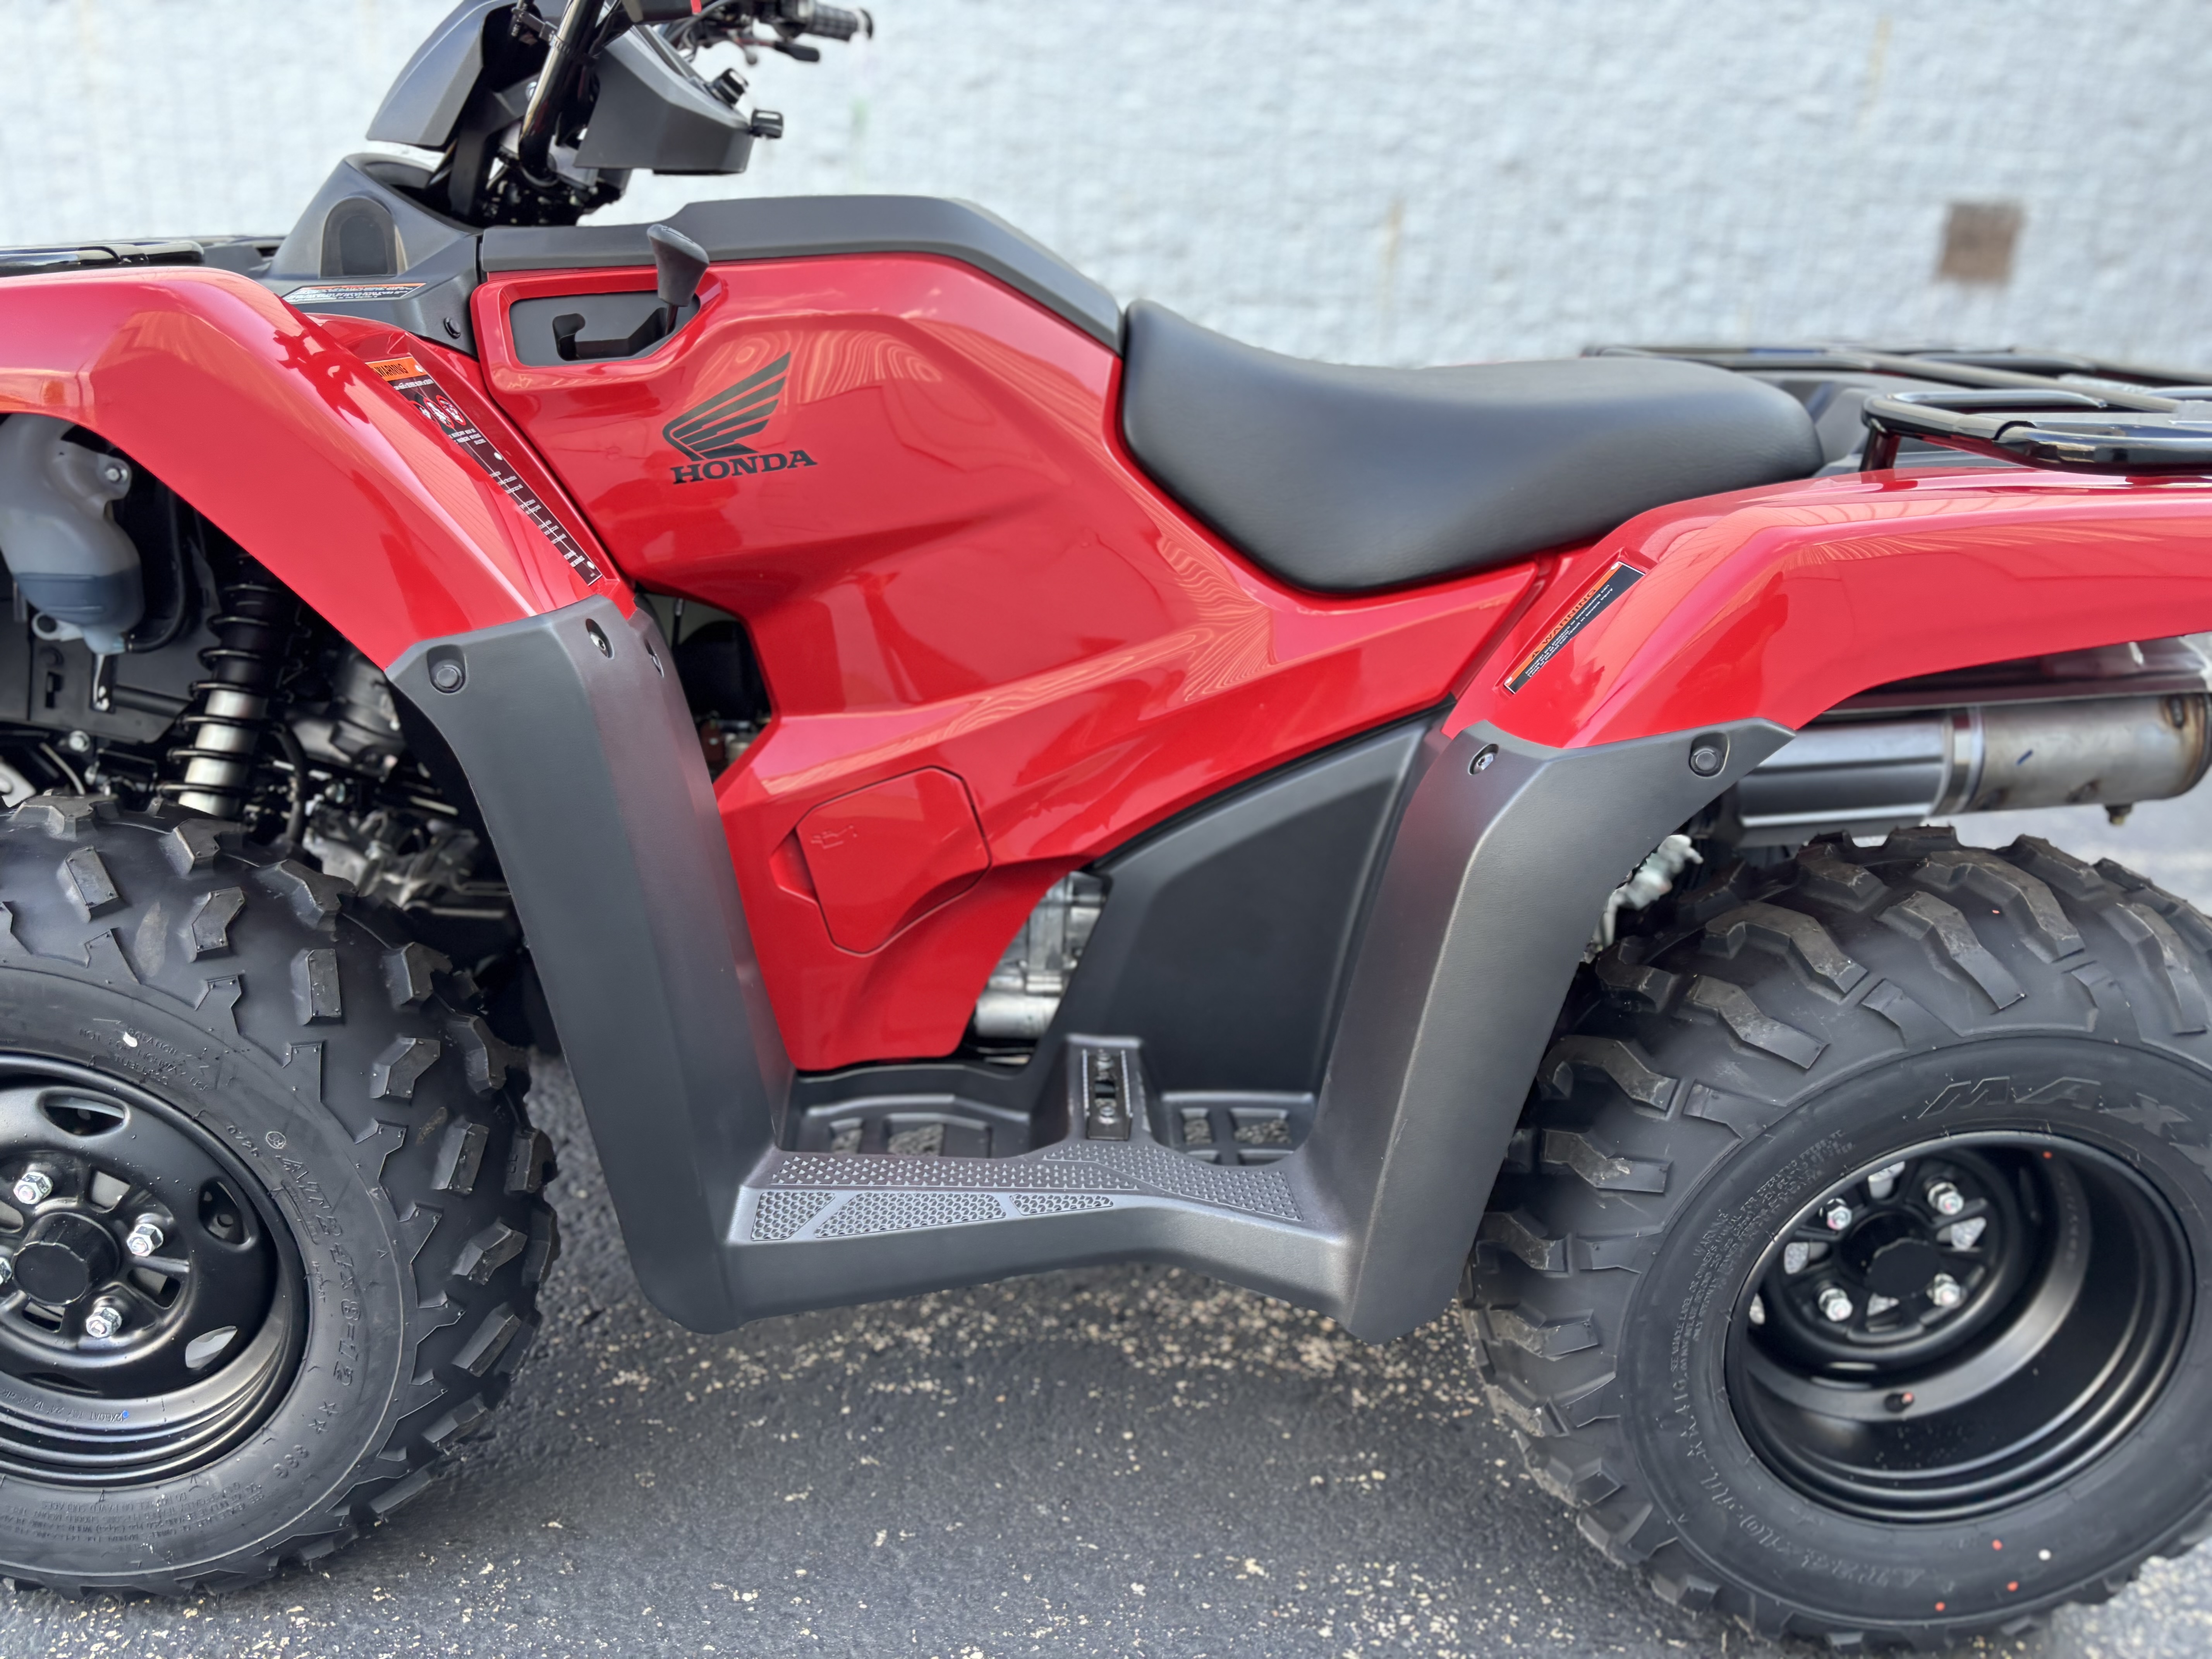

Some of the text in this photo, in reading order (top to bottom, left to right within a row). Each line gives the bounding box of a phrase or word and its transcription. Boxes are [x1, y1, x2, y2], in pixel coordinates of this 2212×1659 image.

[374, 364, 409, 378] WARNING
[670, 450, 817, 484] HONDA
[1543, 589, 1595, 644] WARNING
